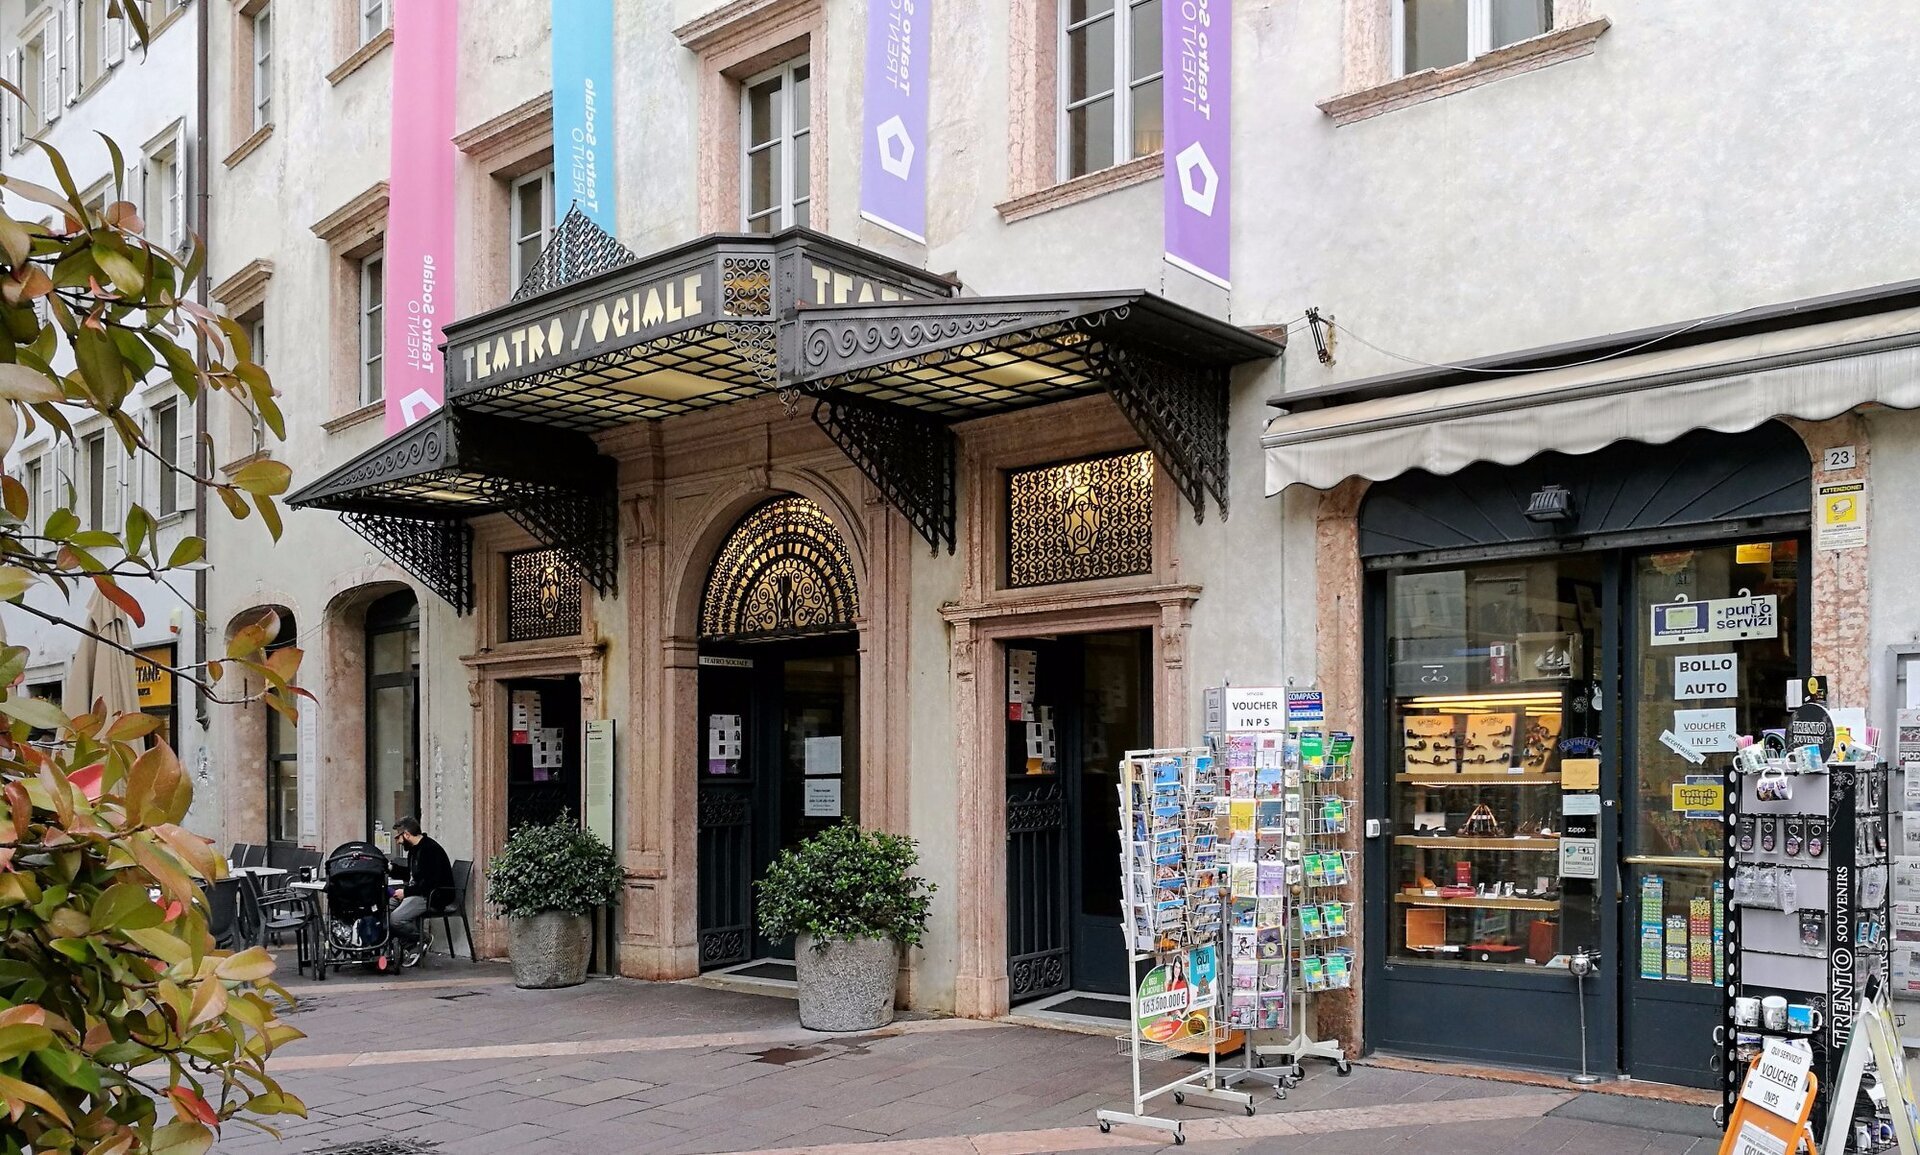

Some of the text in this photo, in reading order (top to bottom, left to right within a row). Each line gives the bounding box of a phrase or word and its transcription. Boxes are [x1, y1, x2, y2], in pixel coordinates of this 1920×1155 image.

[462, 273, 703, 383] TEATRO SOCIALE
[1831, 451, 1850, 466] 23
[1716, 613, 1772, 630] servizi
[1679, 659, 1733, 673] BOLLO
[1684, 682, 1728, 695] AUTO
[1232, 701, 1278, 711] VOUCHER
[1683, 722, 1727, 731] VOUCHER
[1792, 720, 1827, 735] TRENTO
[1560, 737, 1600, 751] SAVINELLI
[1680, 788, 1718, 799] Lotteria
[1684, 796, 1715, 806] Italia
[1196, 953, 1210, 966] QUI
[1832, 866, 1853, 1048] TRENTO SOUVENIRS
[1761, 1062, 1799, 1089] VOUCHER
[1764, 1090, 1780, 1106] INPS
